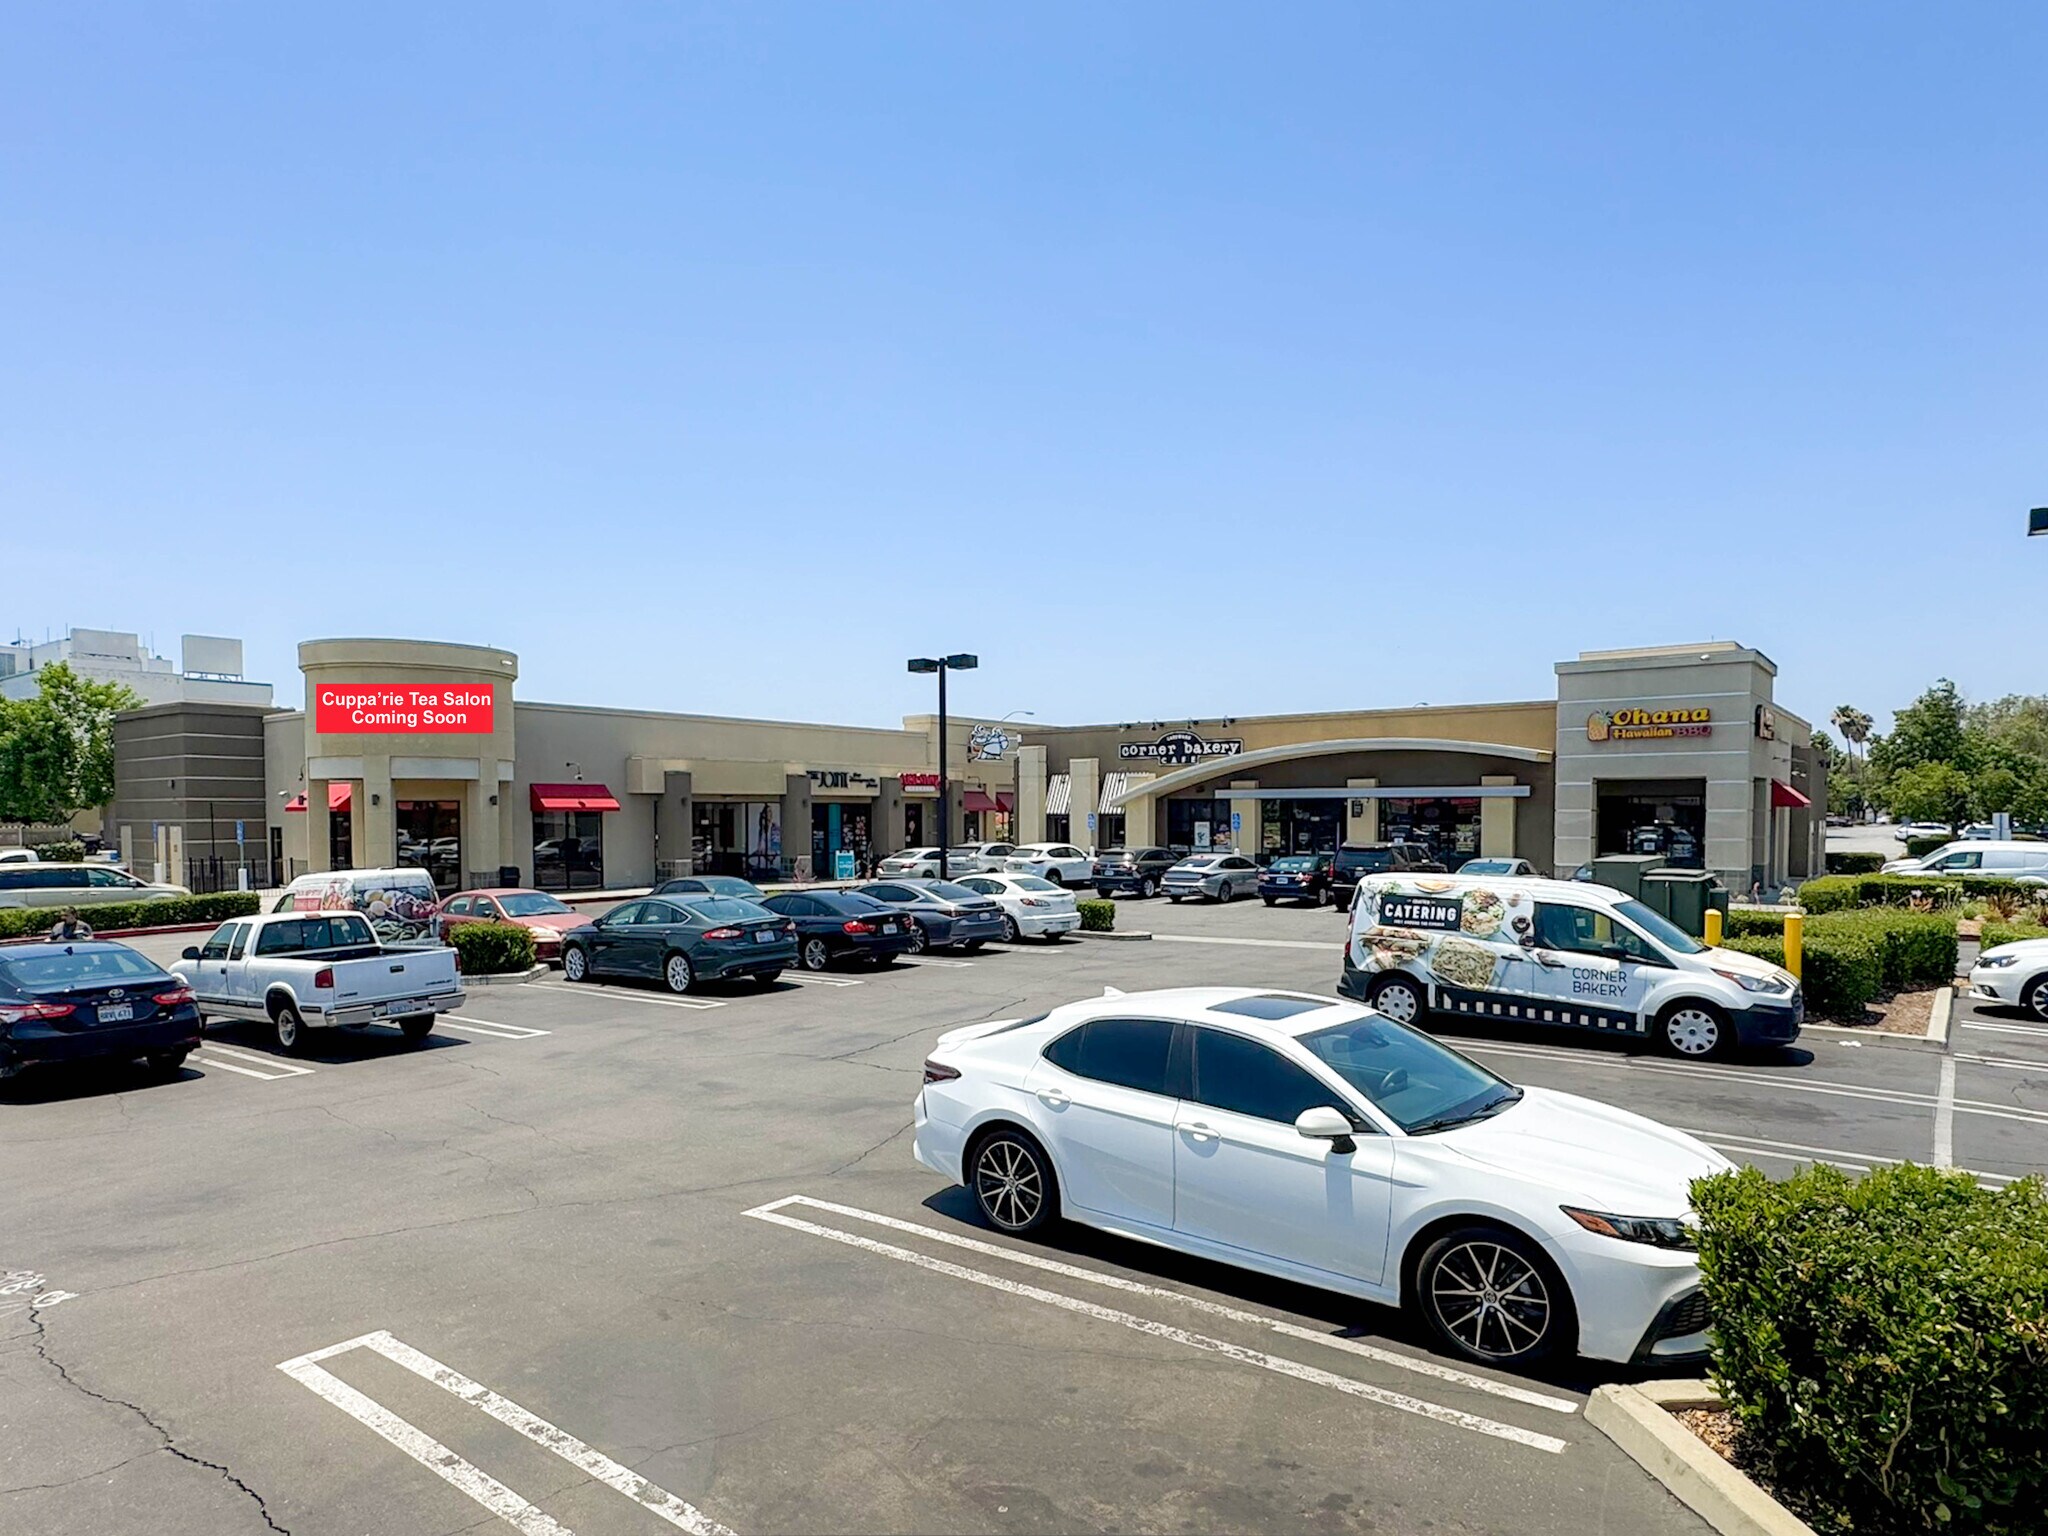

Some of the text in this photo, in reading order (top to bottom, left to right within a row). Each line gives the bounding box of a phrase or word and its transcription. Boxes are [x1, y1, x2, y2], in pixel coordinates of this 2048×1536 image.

[1613, 707, 1711, 726] Ohana
[1613, 725, 1712, 739] Hawaiian BBQ
[1121, 741, 1240, 757] corner bakery
[1384, 903, 1457, 922] CATERING
[1572, 967, 1627, 983] CORNER
[1573, 981, 1627, 997] BAKERY
